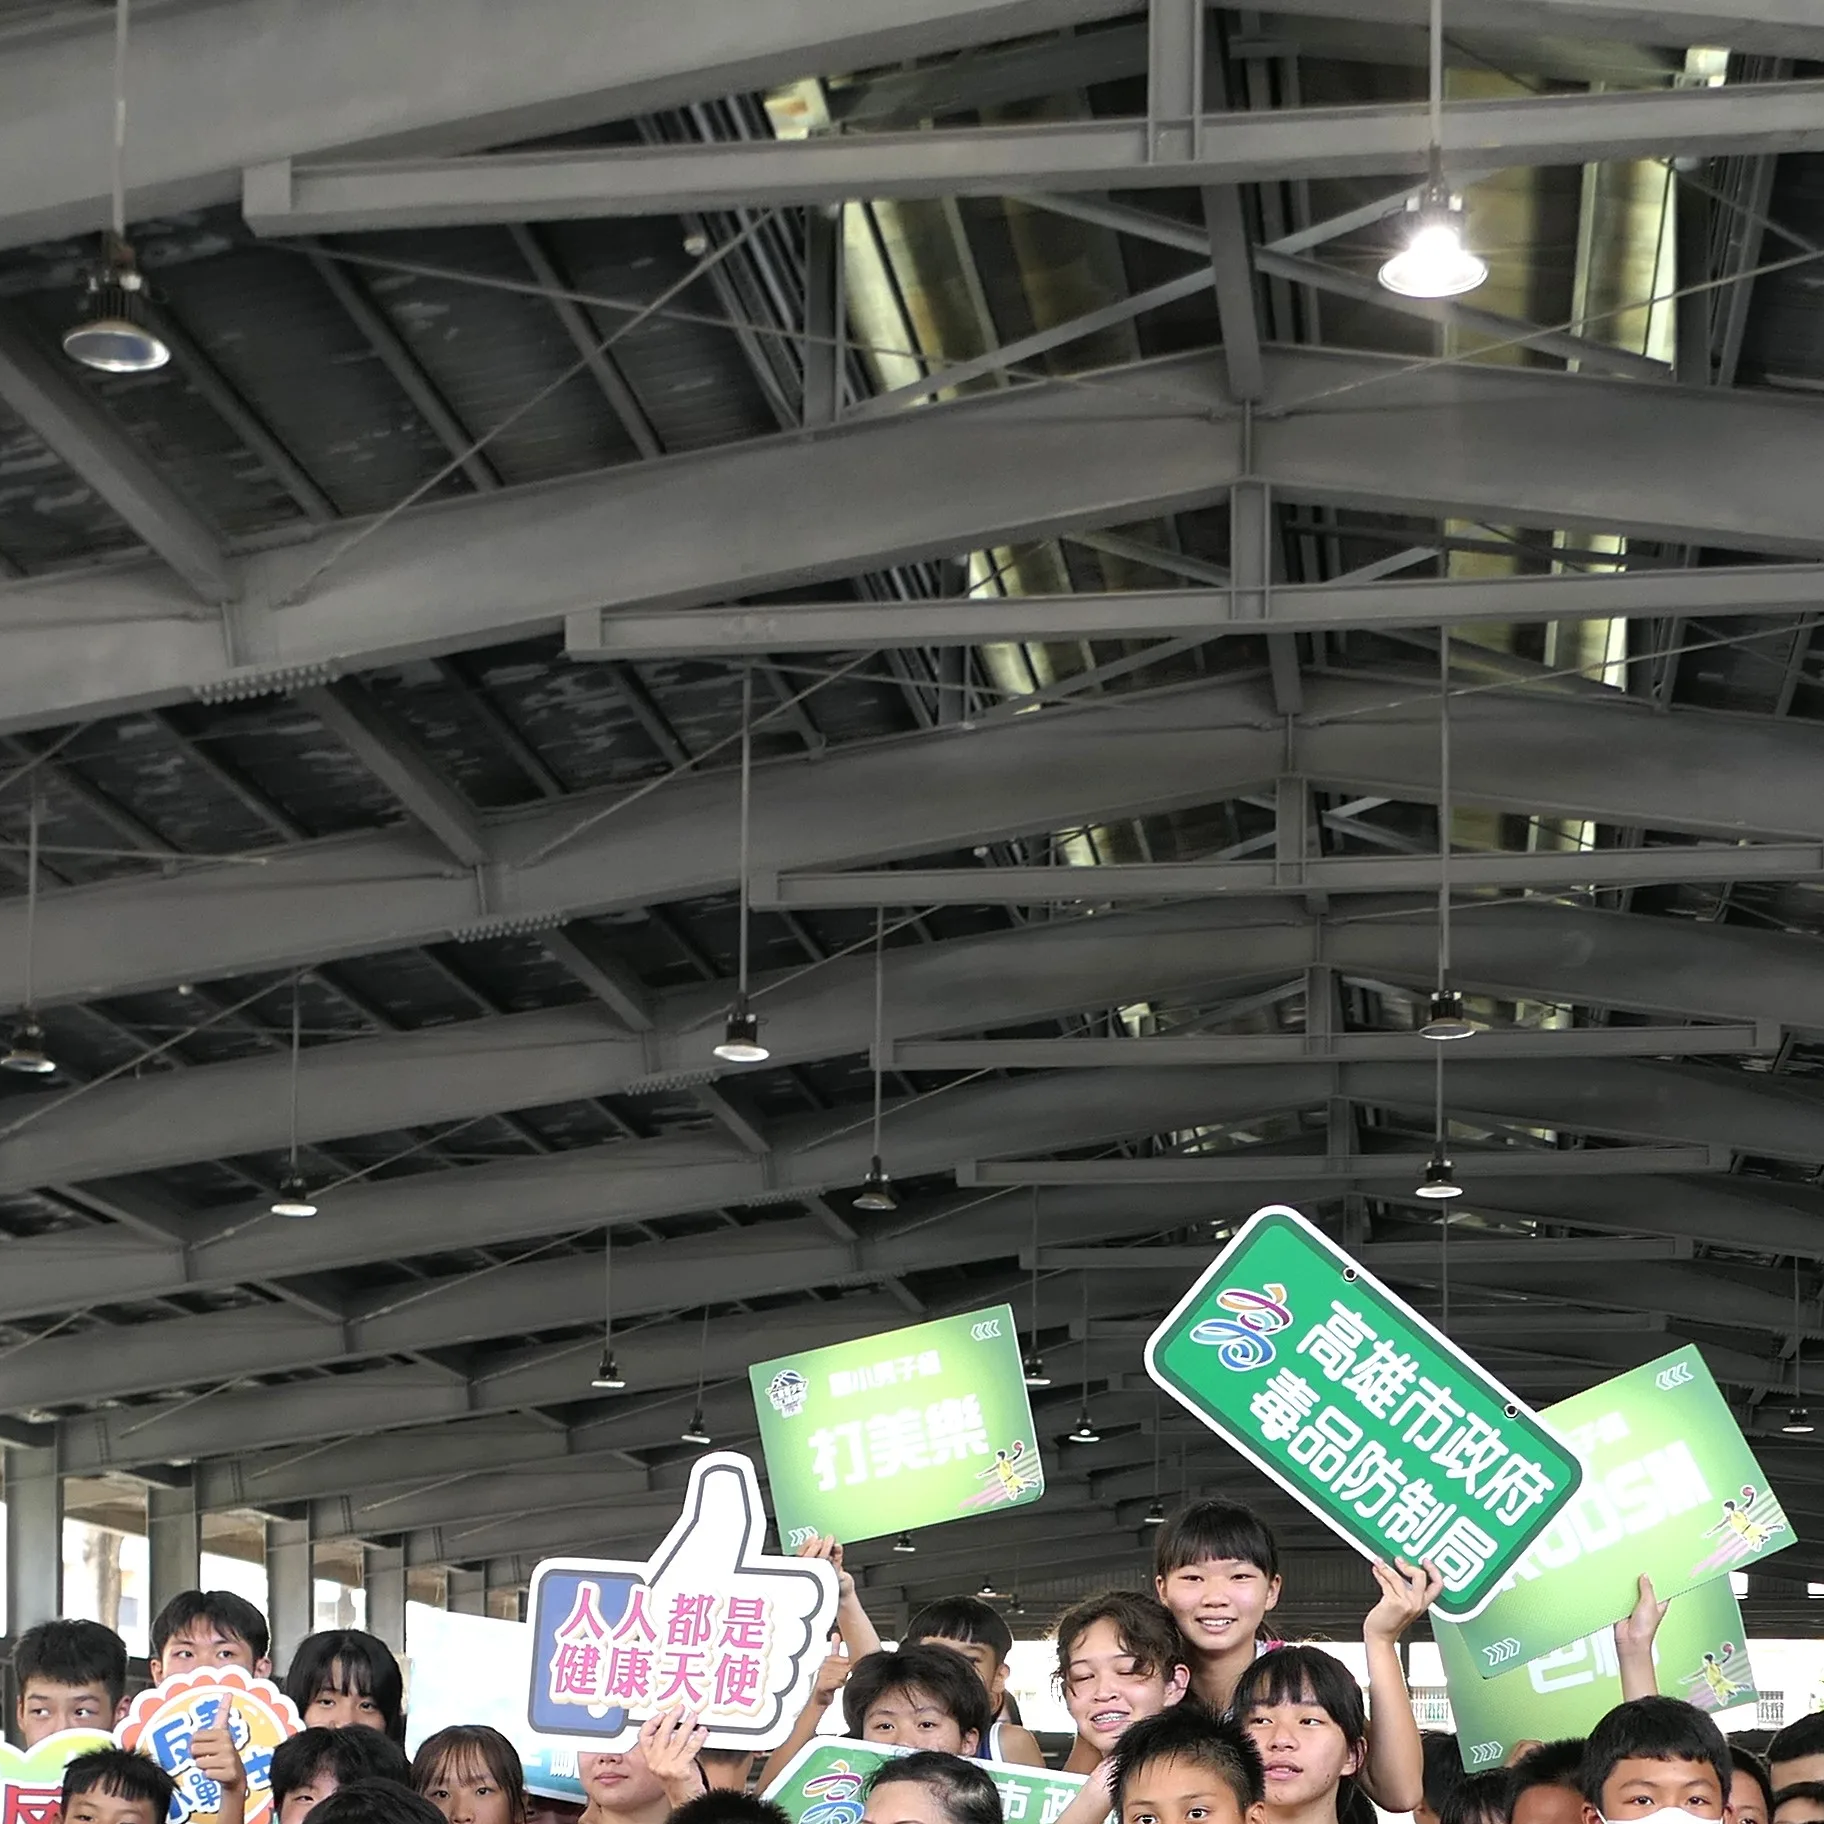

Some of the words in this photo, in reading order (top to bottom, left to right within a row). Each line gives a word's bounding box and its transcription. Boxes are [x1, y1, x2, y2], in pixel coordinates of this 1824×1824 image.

[1250, 1367, 1500, 1593] 毒品防制局
[1295, 1300, 1555, 1526] 高雄市政府
[555, 1643, 760, 1706] 健康天使
[560, 1588, 766, 1649] 人人都是
